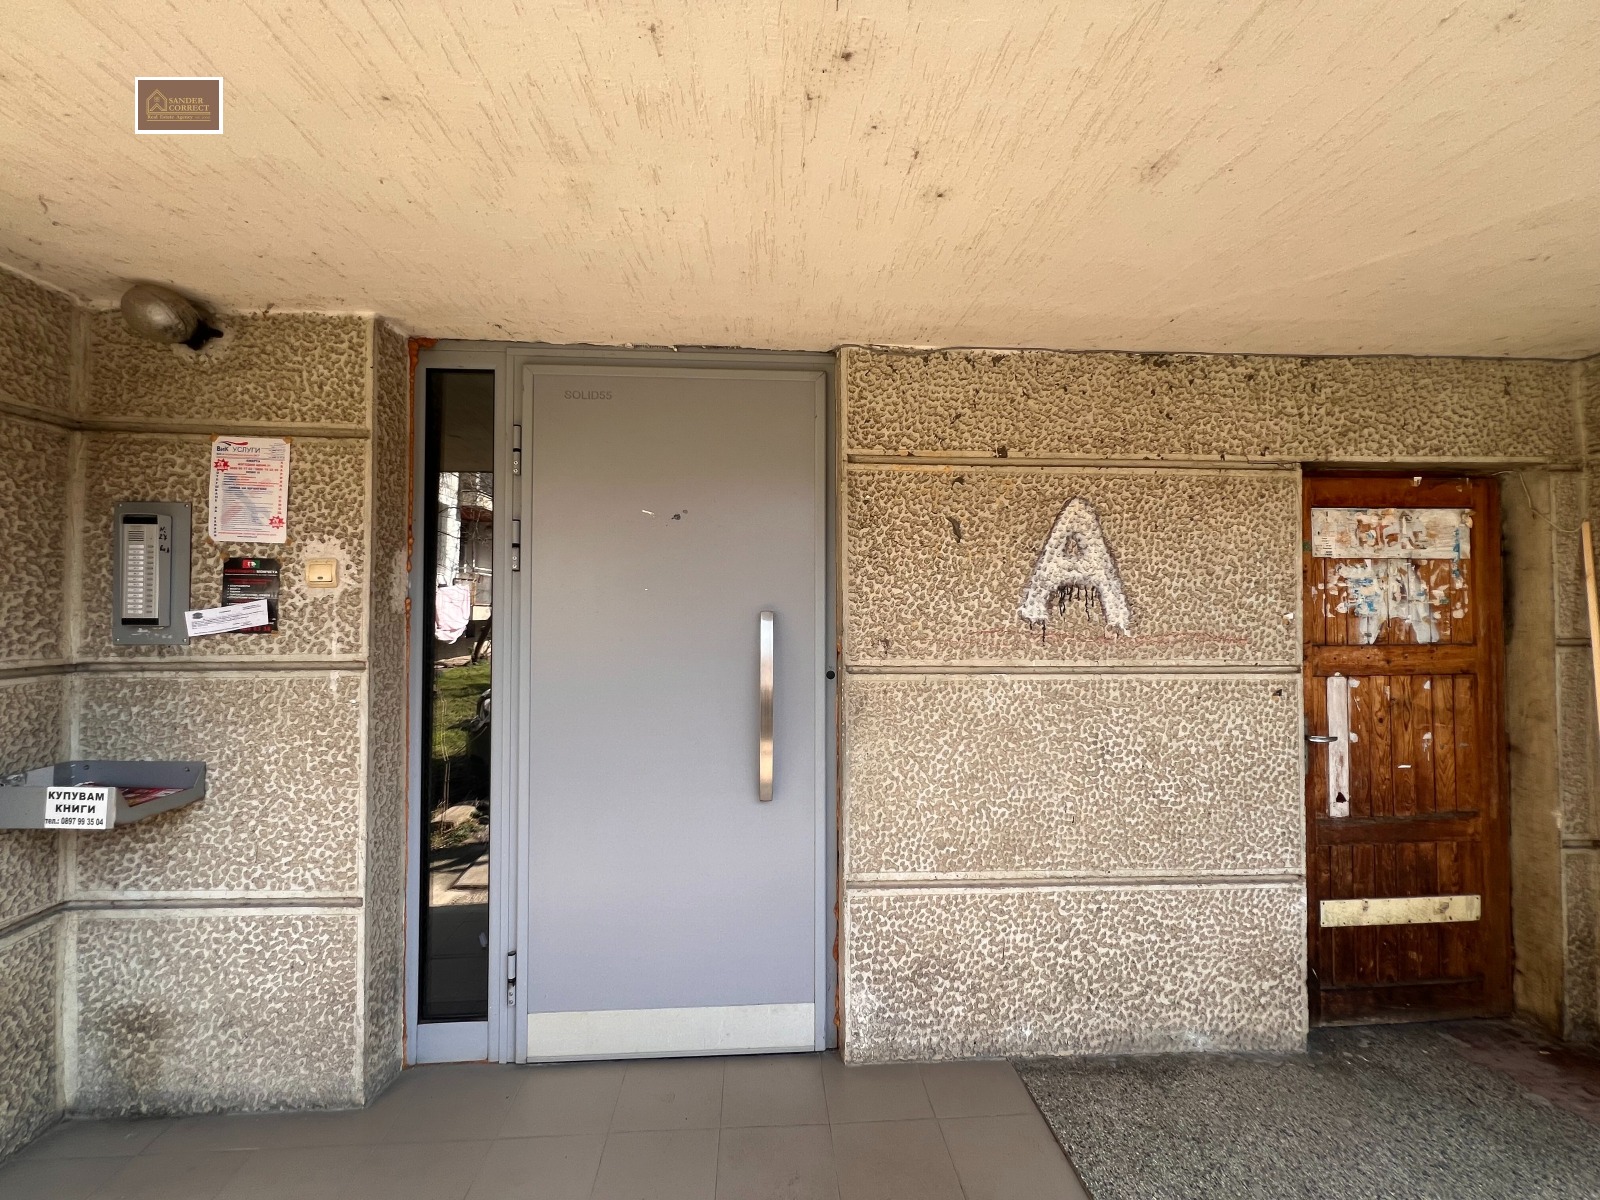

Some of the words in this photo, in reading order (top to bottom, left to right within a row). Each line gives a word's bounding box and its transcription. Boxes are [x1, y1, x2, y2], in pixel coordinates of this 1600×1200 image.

[564, 390, 612, 400] SOLID55
[48, 791, 105, 802] КУПУВАМ
[55, 804, 96, 814] КНИГИ
[61, 817, 76, 825] 0897
[87, 818, 95, 826] 35
[95, 818, 104, 826] 04
